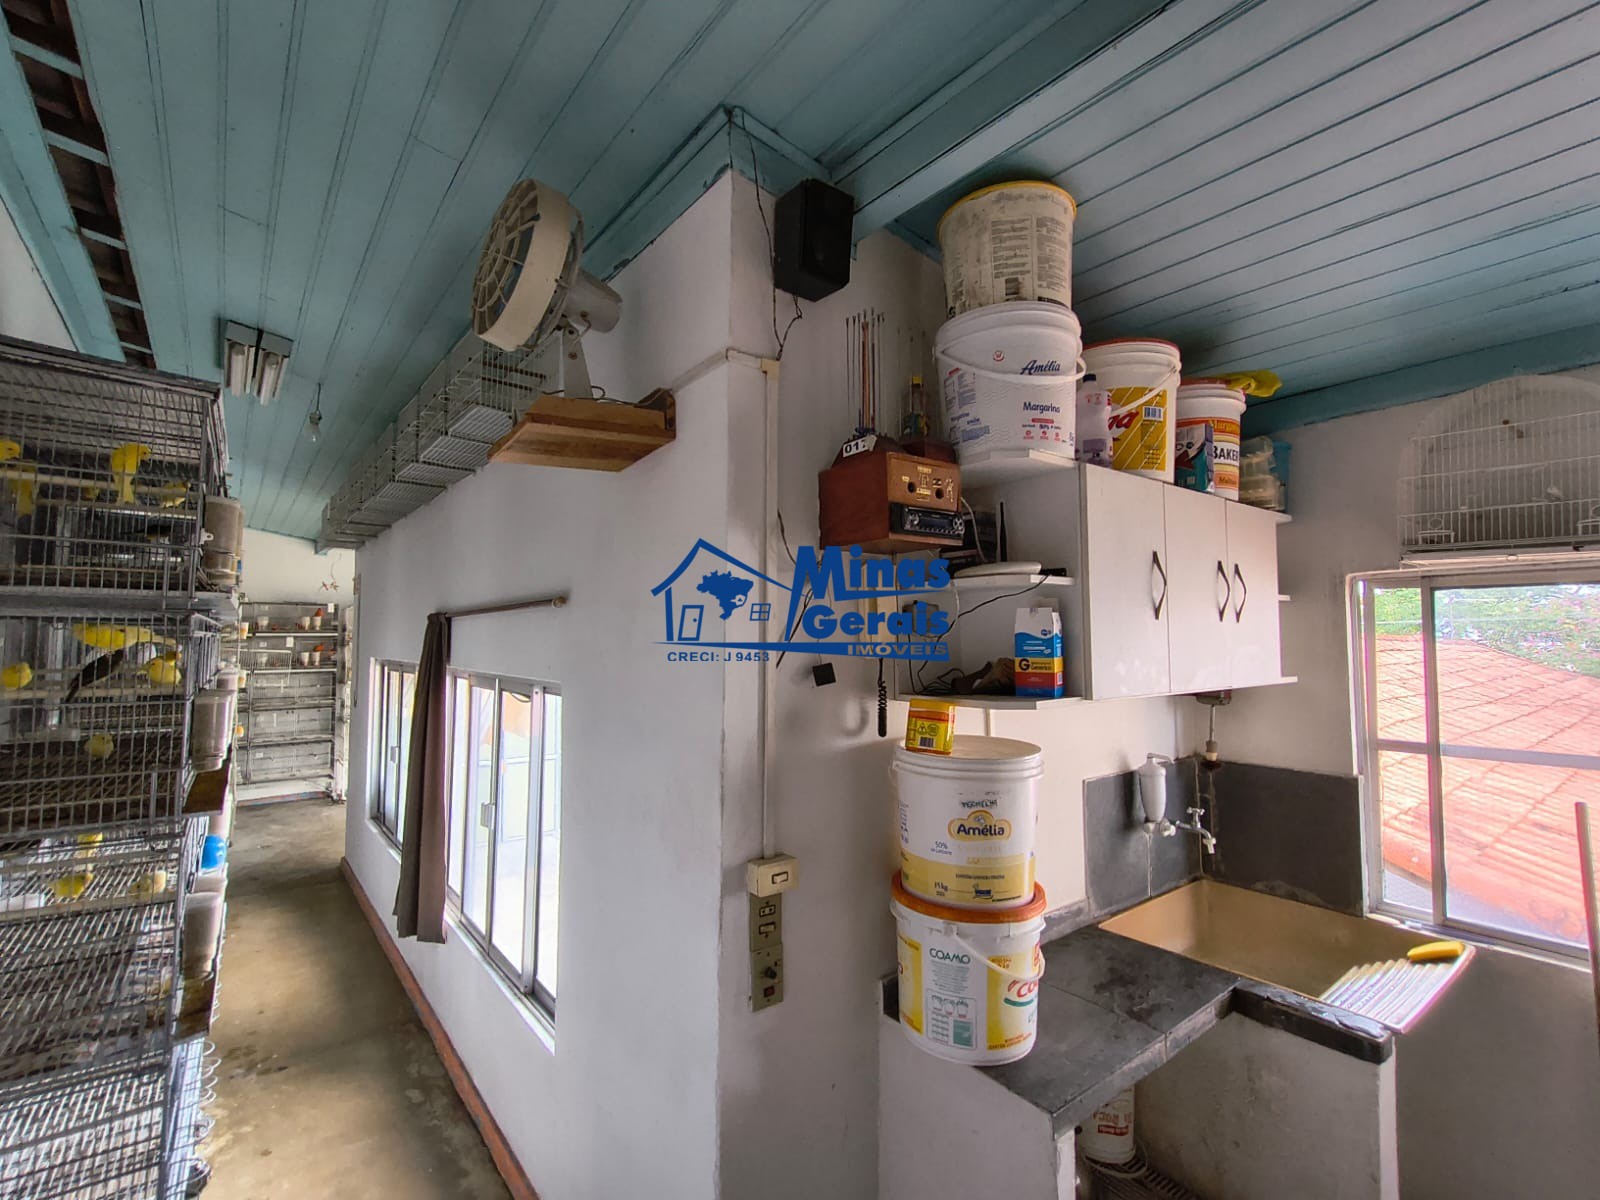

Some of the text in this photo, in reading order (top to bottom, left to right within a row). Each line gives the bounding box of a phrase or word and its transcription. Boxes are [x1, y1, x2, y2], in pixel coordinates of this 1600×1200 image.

[1019, 359, 1061, 376] Amélia
[956, 823, 1005, 837] Amélia
[929, 947, 972, 965] COAMO
